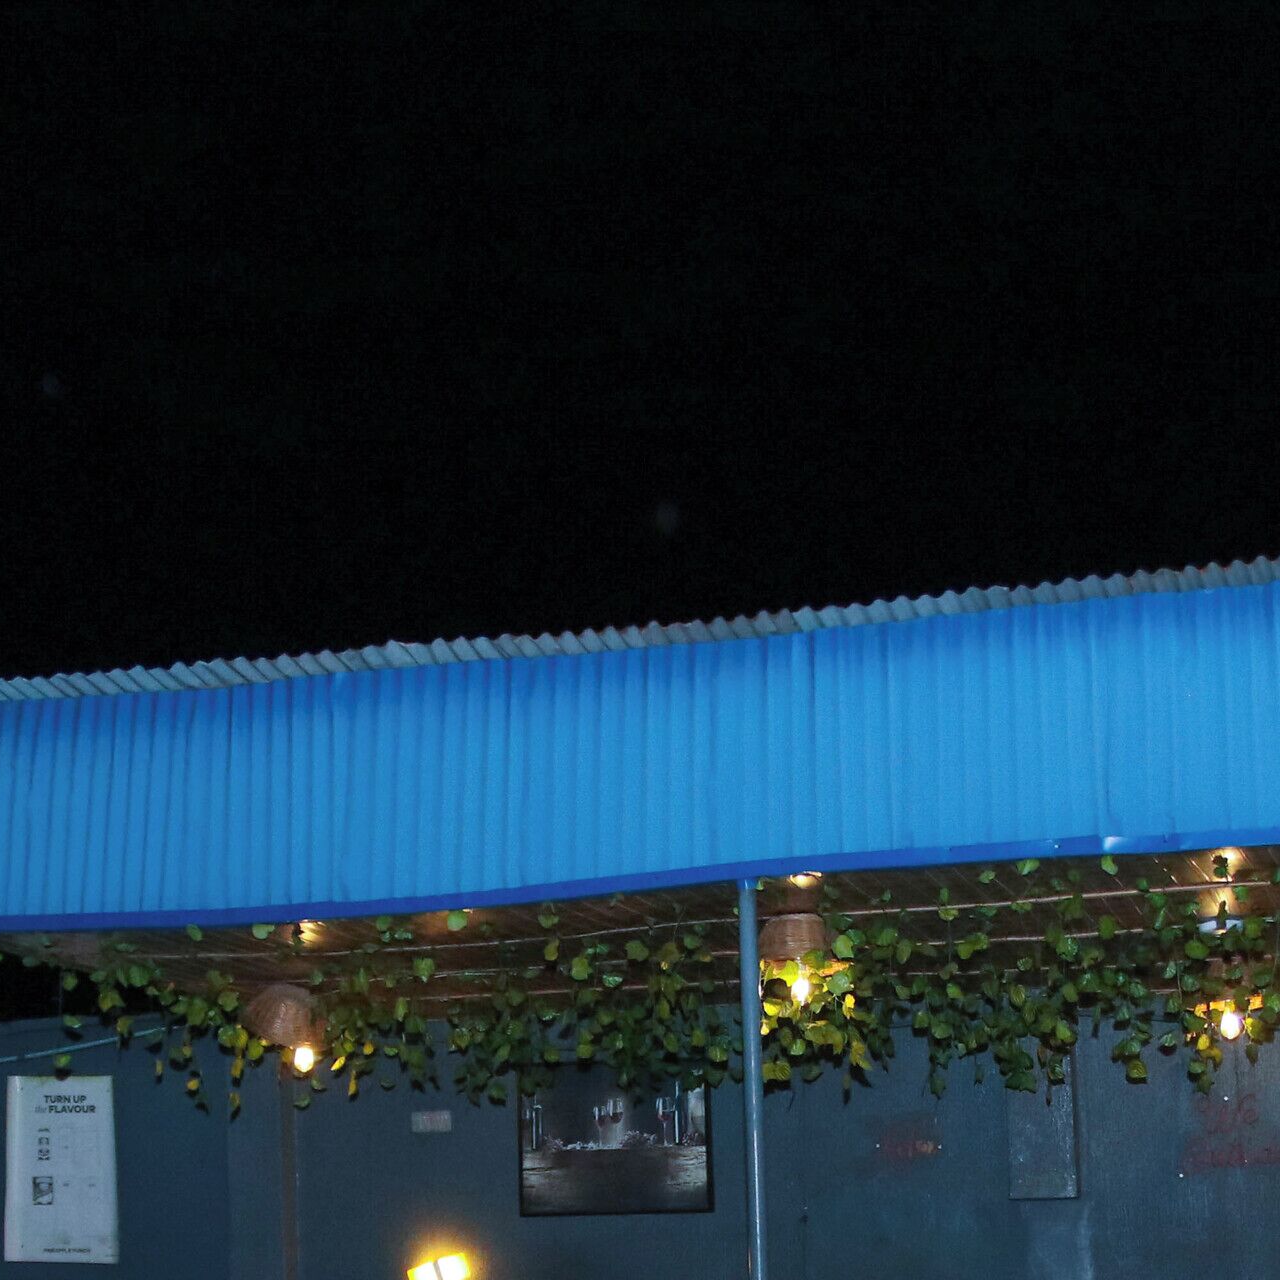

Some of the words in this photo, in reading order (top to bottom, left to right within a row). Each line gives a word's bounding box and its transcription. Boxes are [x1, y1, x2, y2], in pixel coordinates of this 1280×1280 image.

[44, 1095, 71, 1104] TURN
[73, 1095, 87, 1104] UP
[48, 1105, 96, 1113] FLAVOUR
